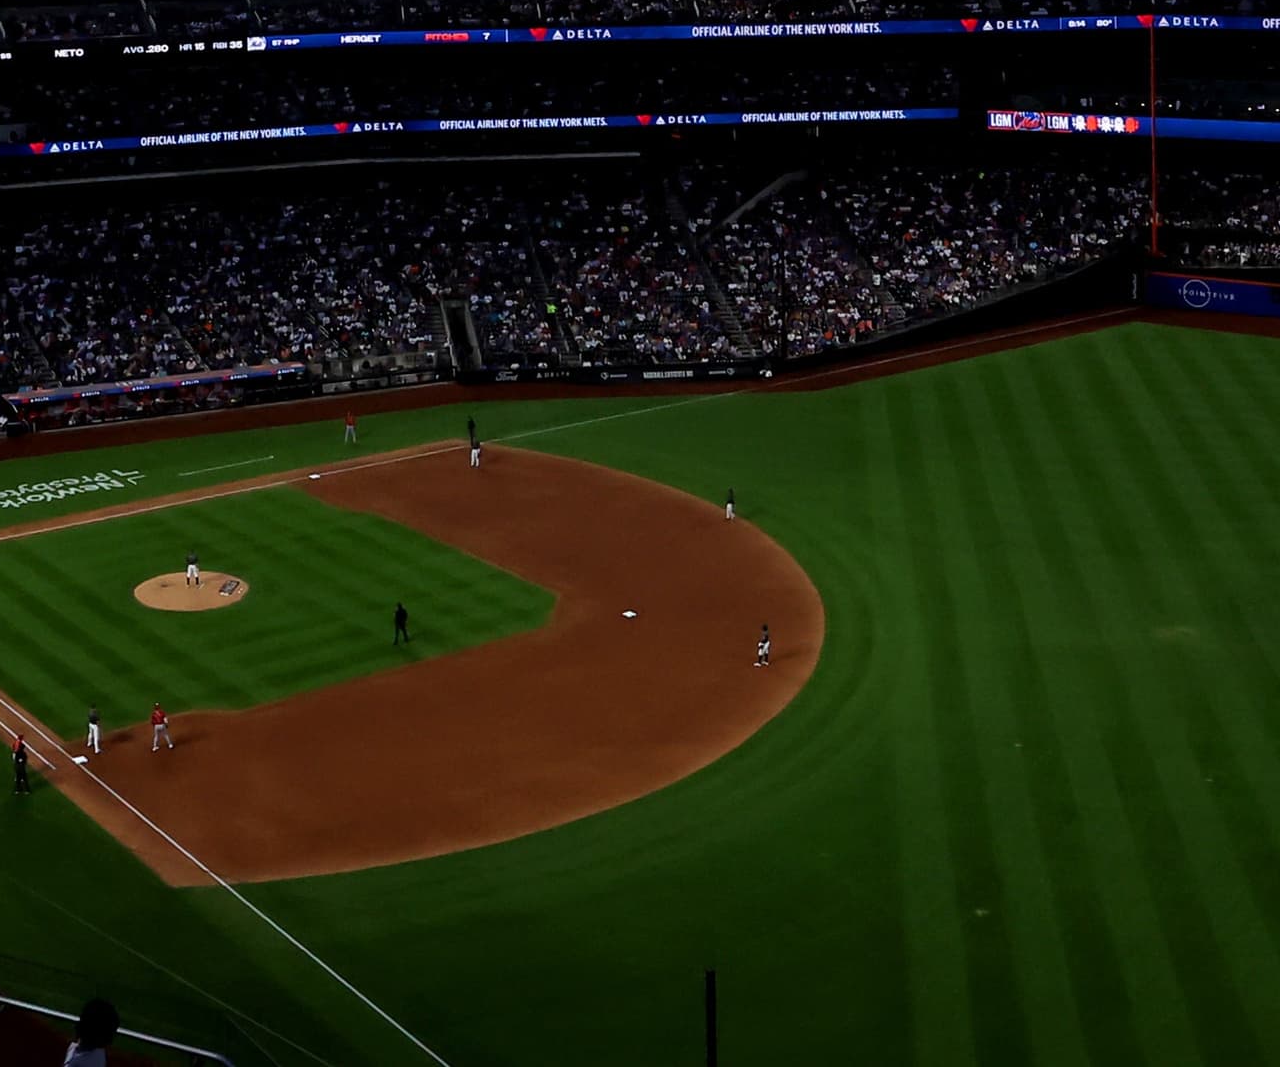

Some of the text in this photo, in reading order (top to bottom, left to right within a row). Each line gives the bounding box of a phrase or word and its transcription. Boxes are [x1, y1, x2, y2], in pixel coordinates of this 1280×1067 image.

[996, 19, 1040, 30] DELTA
[1172, 17, 1218, 28] DELTA
[341, 35, 381, 44] HERGET
[567, 29, 611, 39] DELTA
[55, 48, 84, 58] NETO
[991, 113, 1012, 127] LGM
[1047, 115, 1069, 129] LGM
[364, 123, 403, 131] DELTA
[62, 140, 103, 152] DELTA
